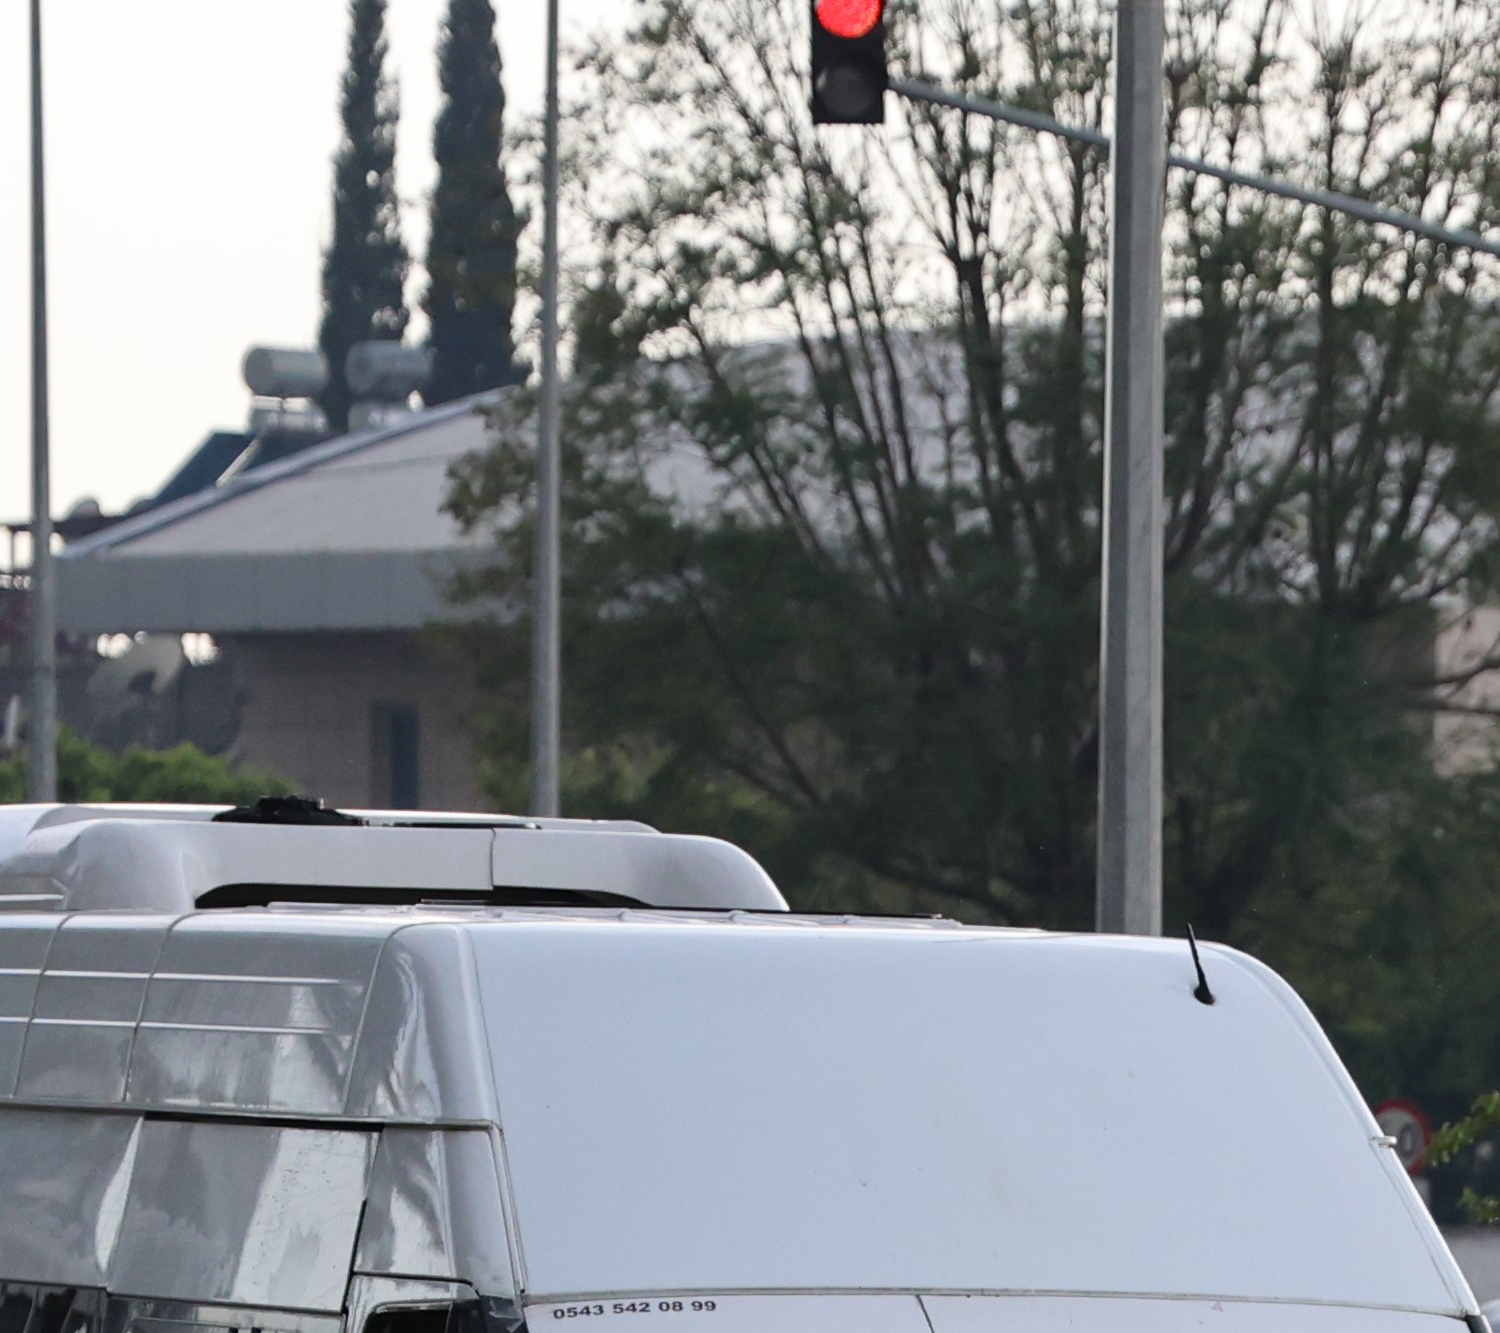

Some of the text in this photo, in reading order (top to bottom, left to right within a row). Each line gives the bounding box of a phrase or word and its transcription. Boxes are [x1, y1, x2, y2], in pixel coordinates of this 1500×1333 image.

[553, 1301, 716, 1319] 0543 542 08 99
